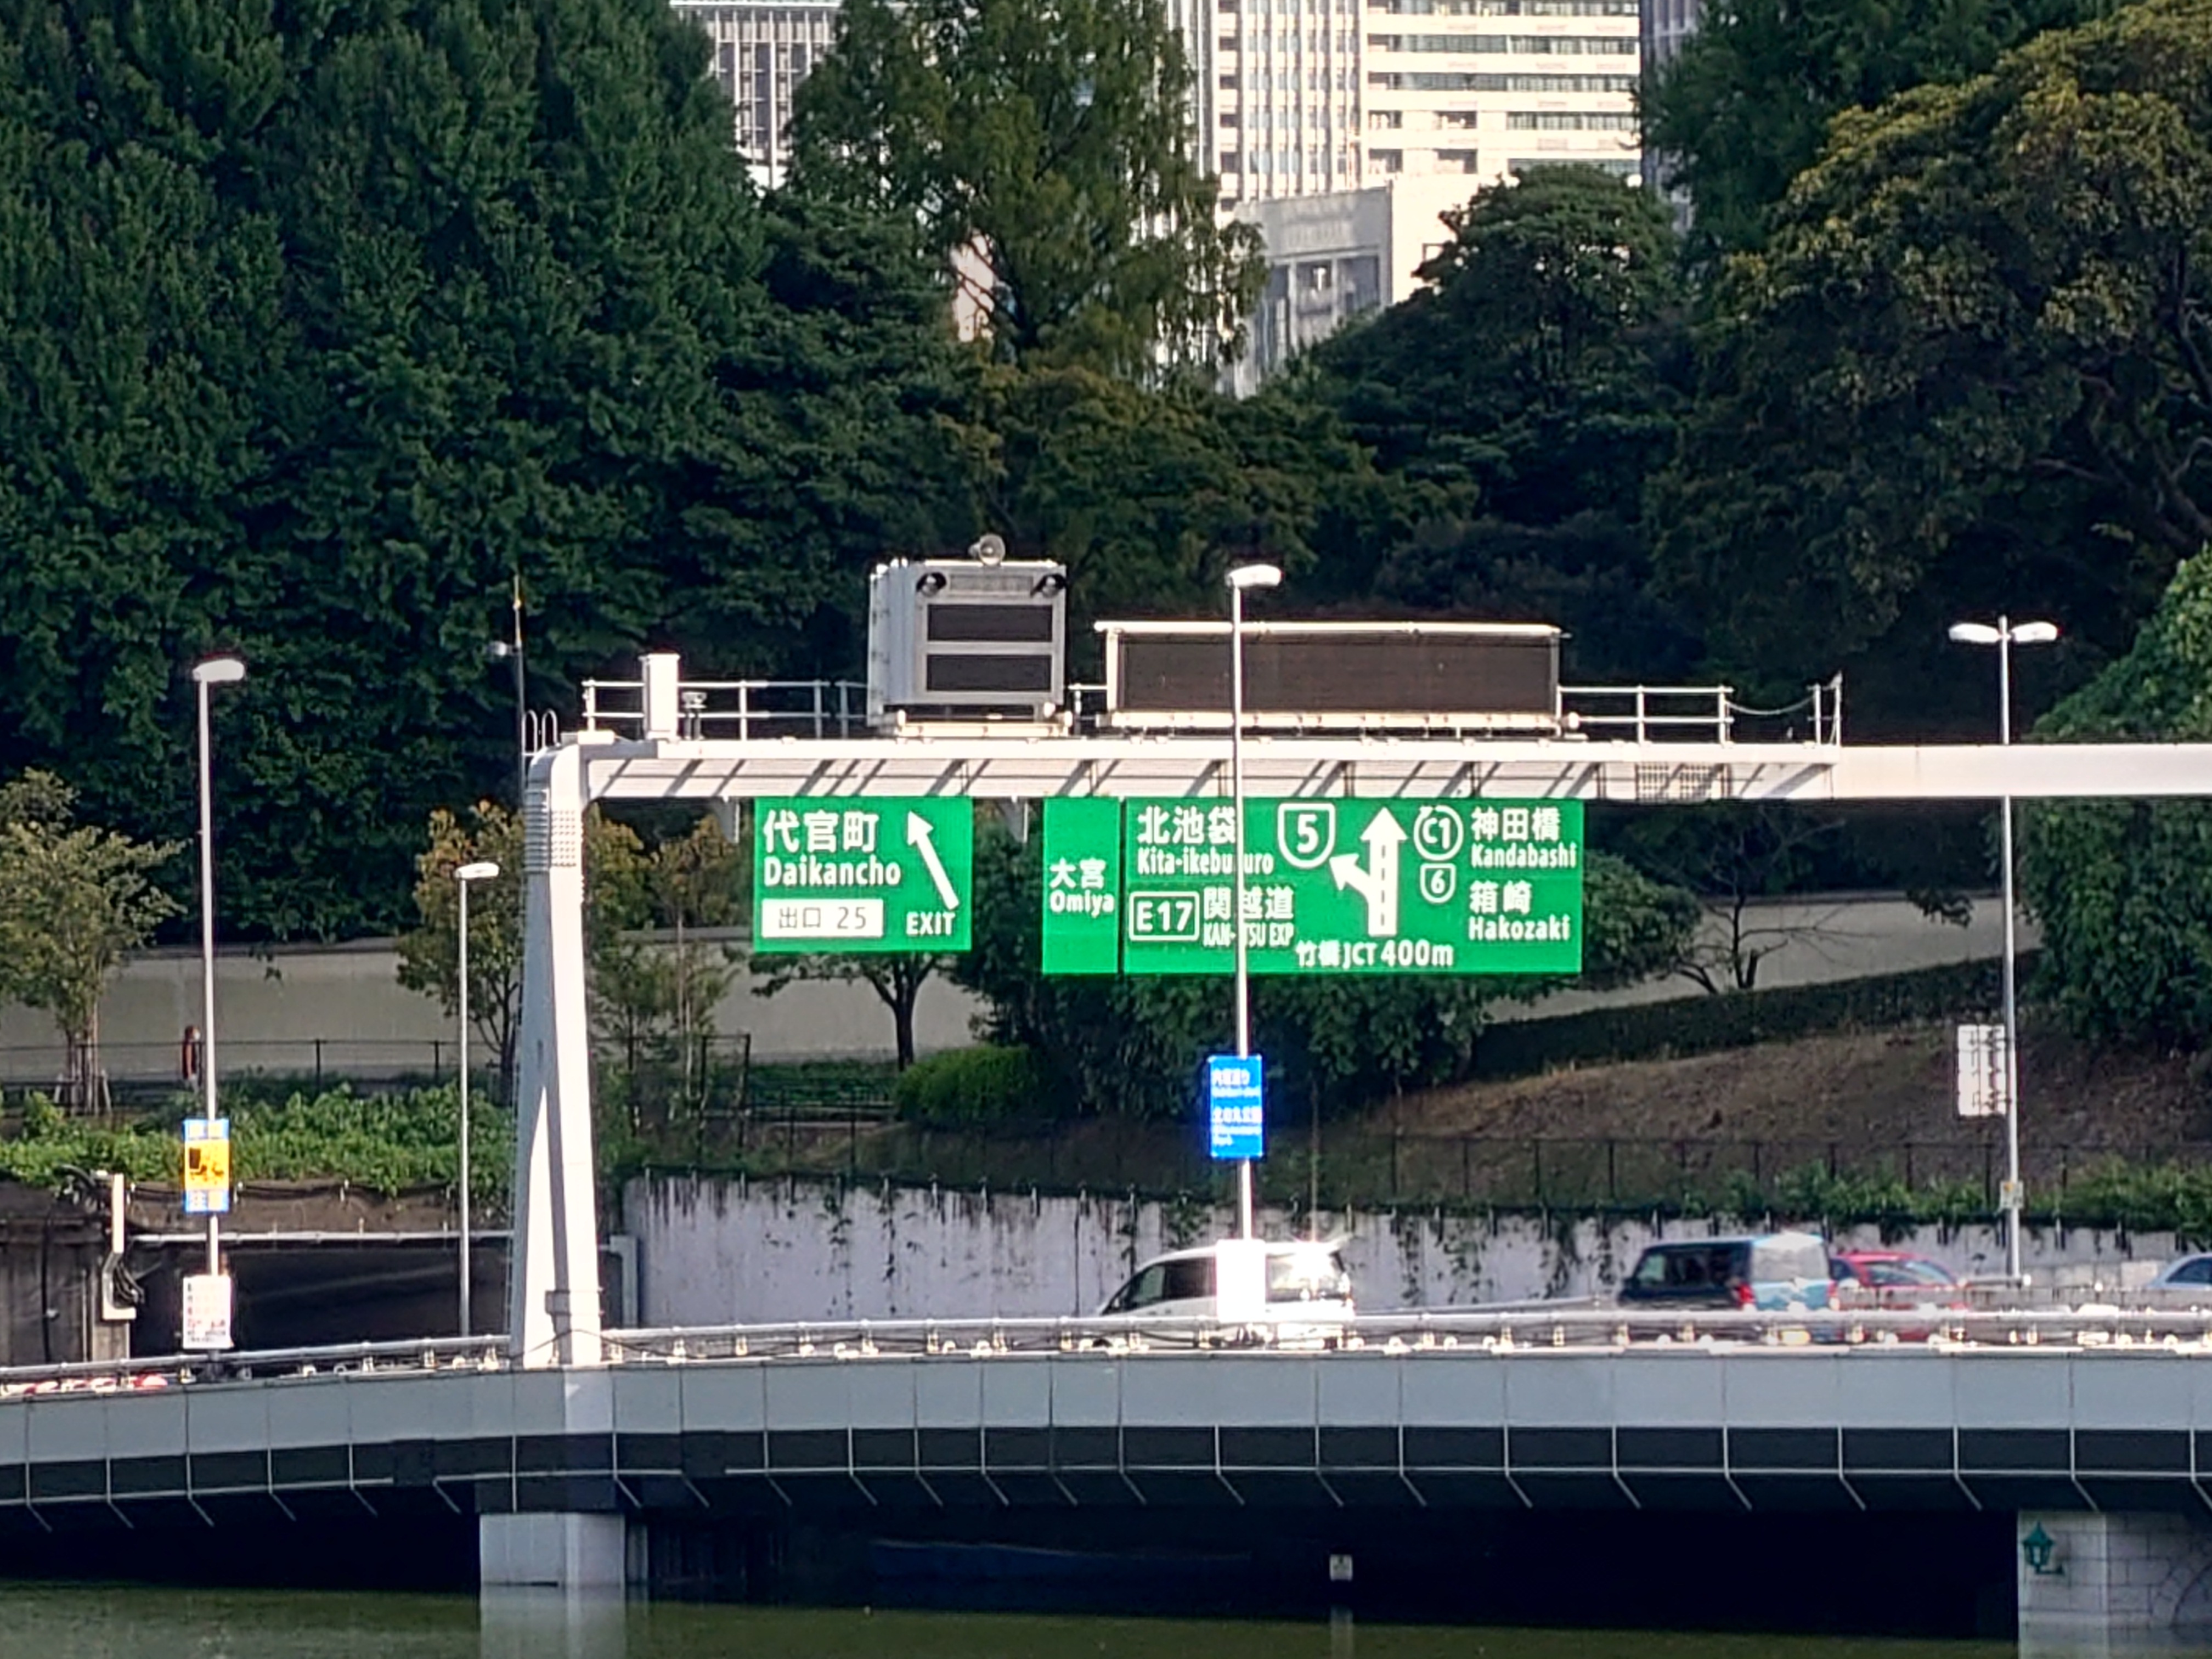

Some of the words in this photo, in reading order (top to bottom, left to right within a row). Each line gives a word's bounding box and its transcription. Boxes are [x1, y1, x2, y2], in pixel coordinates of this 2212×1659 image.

[764, 810, 878, 853] 代官町
[1138, 806, 1235, 844] 北池袋
[1297, 814, 1318, 853] 5
[1422, 817, 1450, 850] C1
[1471, 807, 1560, 841] 神田橋
[1138, 845, 1273, 874] Kita-ikebuuro
[1471, 843, 1576, 867] Kandabashi
[765, 855, 900, 886] Daikancho
[1050, 859, 1105, 888] 大宮
[1430, 869, 1446, 894] 6
[1050, 890, 1114, 917] Omiya
[1203, 887, 1294, 919] 関越道
[1470, 881, 1531, 914] 箱崎
[779, 907, 821, 929] 出口
[837, 907, 866, 929] 25
[907, 912, 955, 935] EXIT
[1137, 901, 1193, 931] E17
[1469, 915, 1569, 940] Hakozaki
[1269, 923, 1294, 946] EXP
[1381, 940, 1453, 967] 400m
